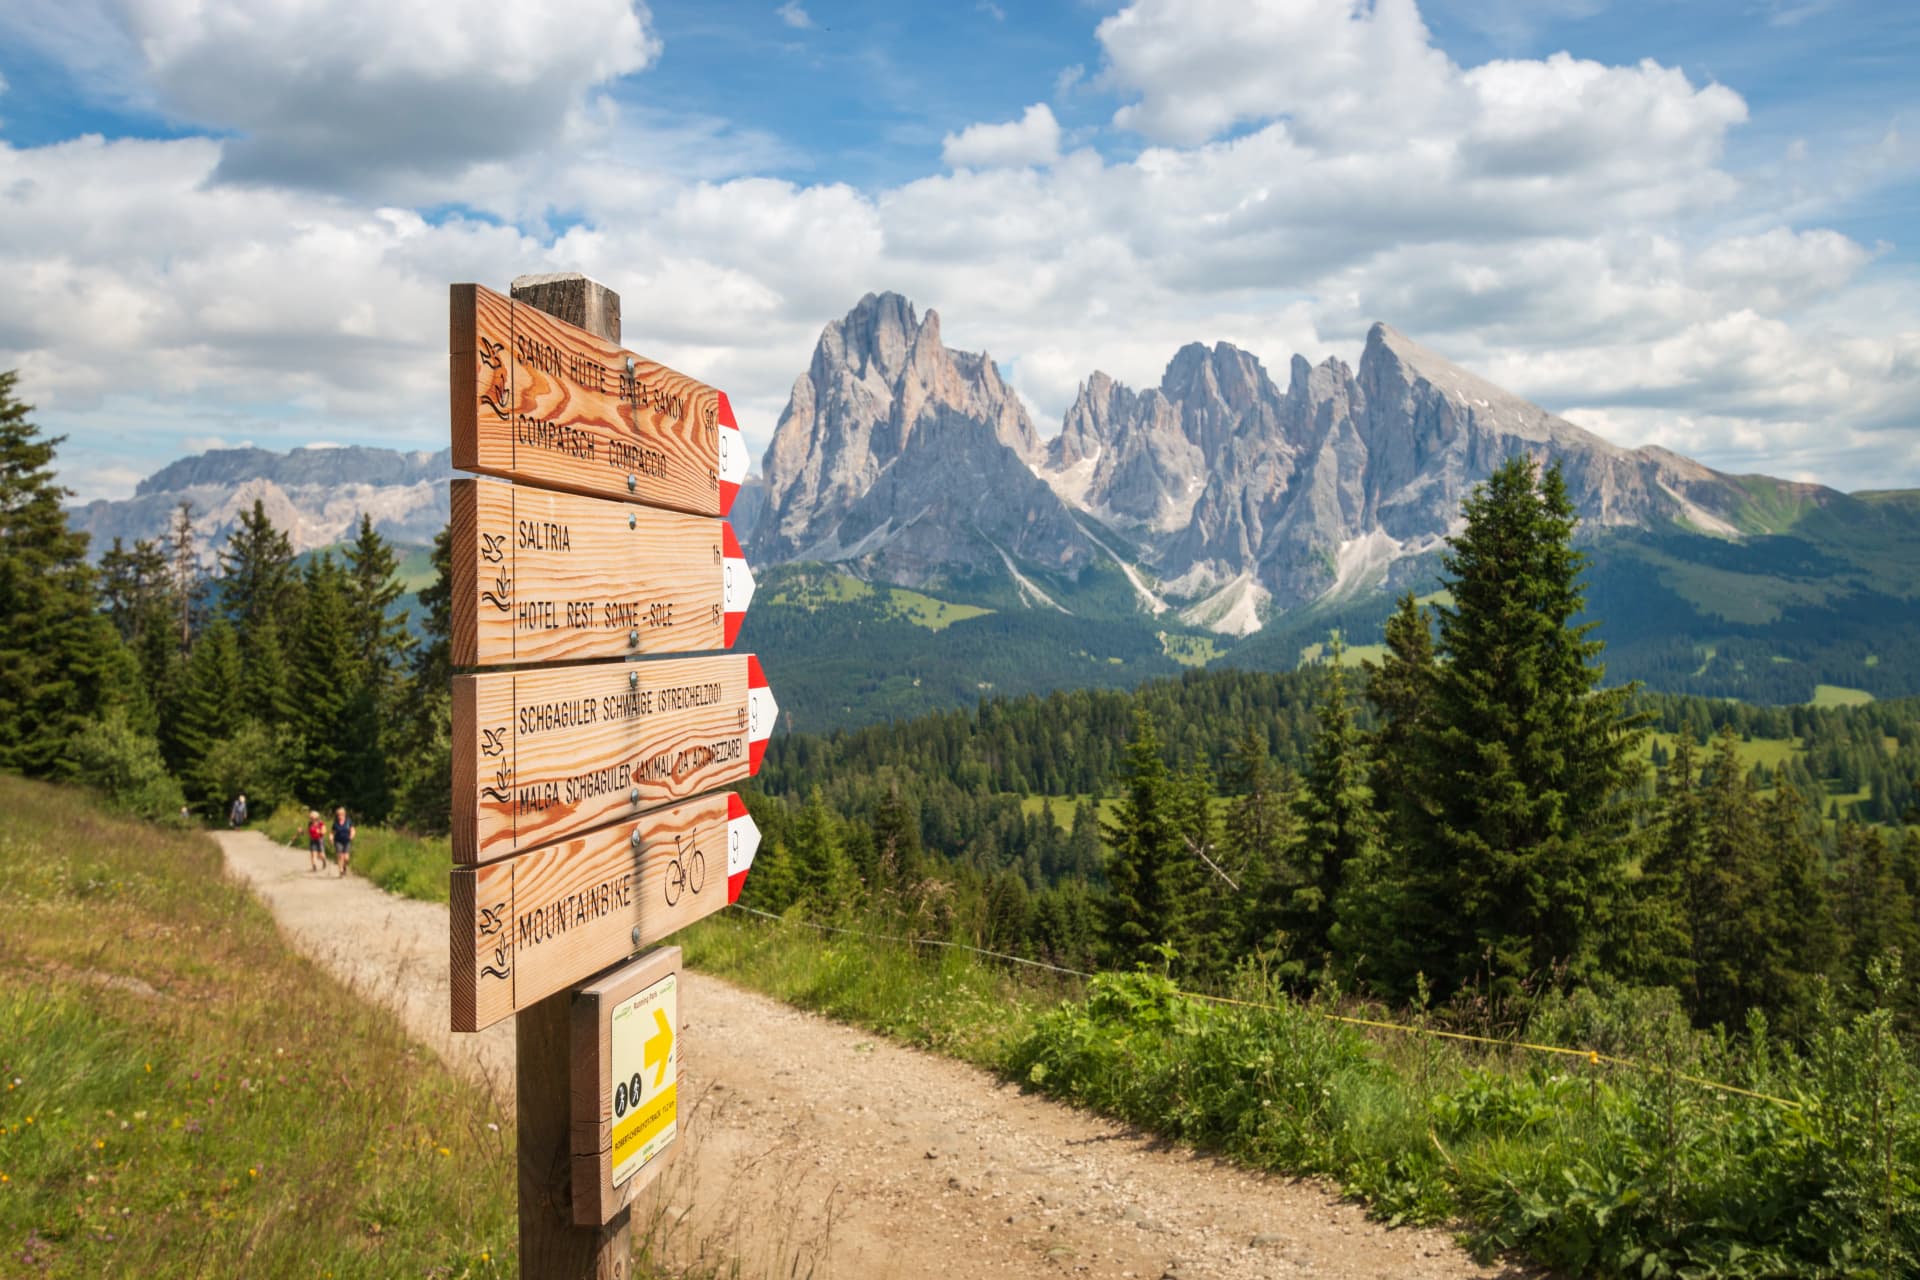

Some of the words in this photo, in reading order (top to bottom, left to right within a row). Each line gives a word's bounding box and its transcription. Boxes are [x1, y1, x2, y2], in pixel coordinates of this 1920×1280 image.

[516, 335, 563, 379] SANON
[570, 352, 607, 394] HÜTTE
[619, 374, 649, 408] BAITA
[653, 388, 685, 421] SANON
[518, 413, 595, 461] COMPATSCH
[608, 439, 667, 479] COMPACCIO
[518, 520, 571, 552] SALTRIA
[712, 543, 721, 566] 1h
[519, 600, 559, 630] HOTEL
[566, 602, 598, 629] REST.
[518, 697, 597, 735] SCHGAGULER
[602, 690, 653, 722] SCHWAIGE
[658, 682, 722, 713] (STREICHELZOO)
[518, 785, 560, 816] MALGA
[565, 765, 631, 804] SCHGAGULER
[732, 830, 739, 864] 9
[518, 873, 632, 950] MOUNTAINBIKE
